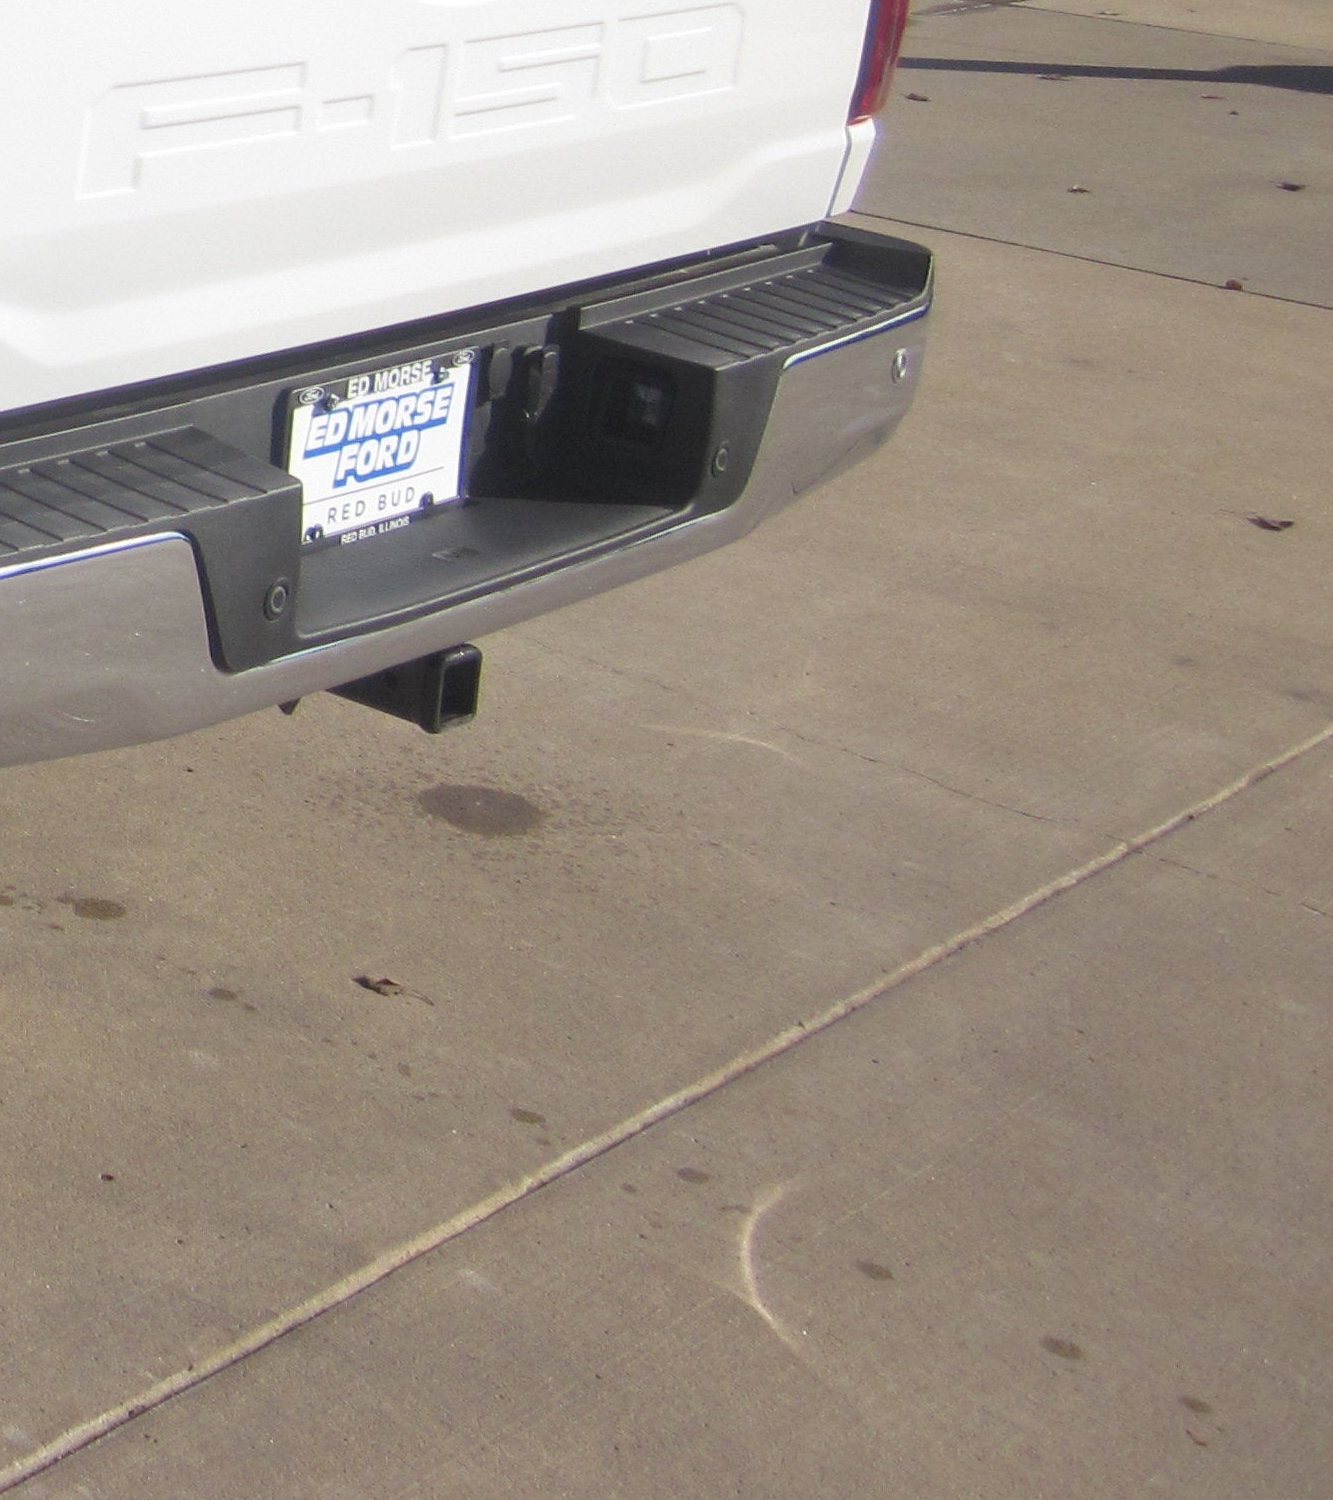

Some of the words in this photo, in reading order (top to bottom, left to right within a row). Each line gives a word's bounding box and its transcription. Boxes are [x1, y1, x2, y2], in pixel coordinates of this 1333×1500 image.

[76, 2, 746, 200] F-150
[347, 376, 370, 399] ED
[374, 359, 434, 392] MORSE
[305, 408, 350, 456] ED
[348, 386, 454, 440] MORSE
[334, 429, 421, 485] FORD
[327, 497, 367, 524] RED
[377, 485, 416, 511] BUD
[341, 531, 358, 545] RED
[378, 515, 410, 534] ILLINOIS
